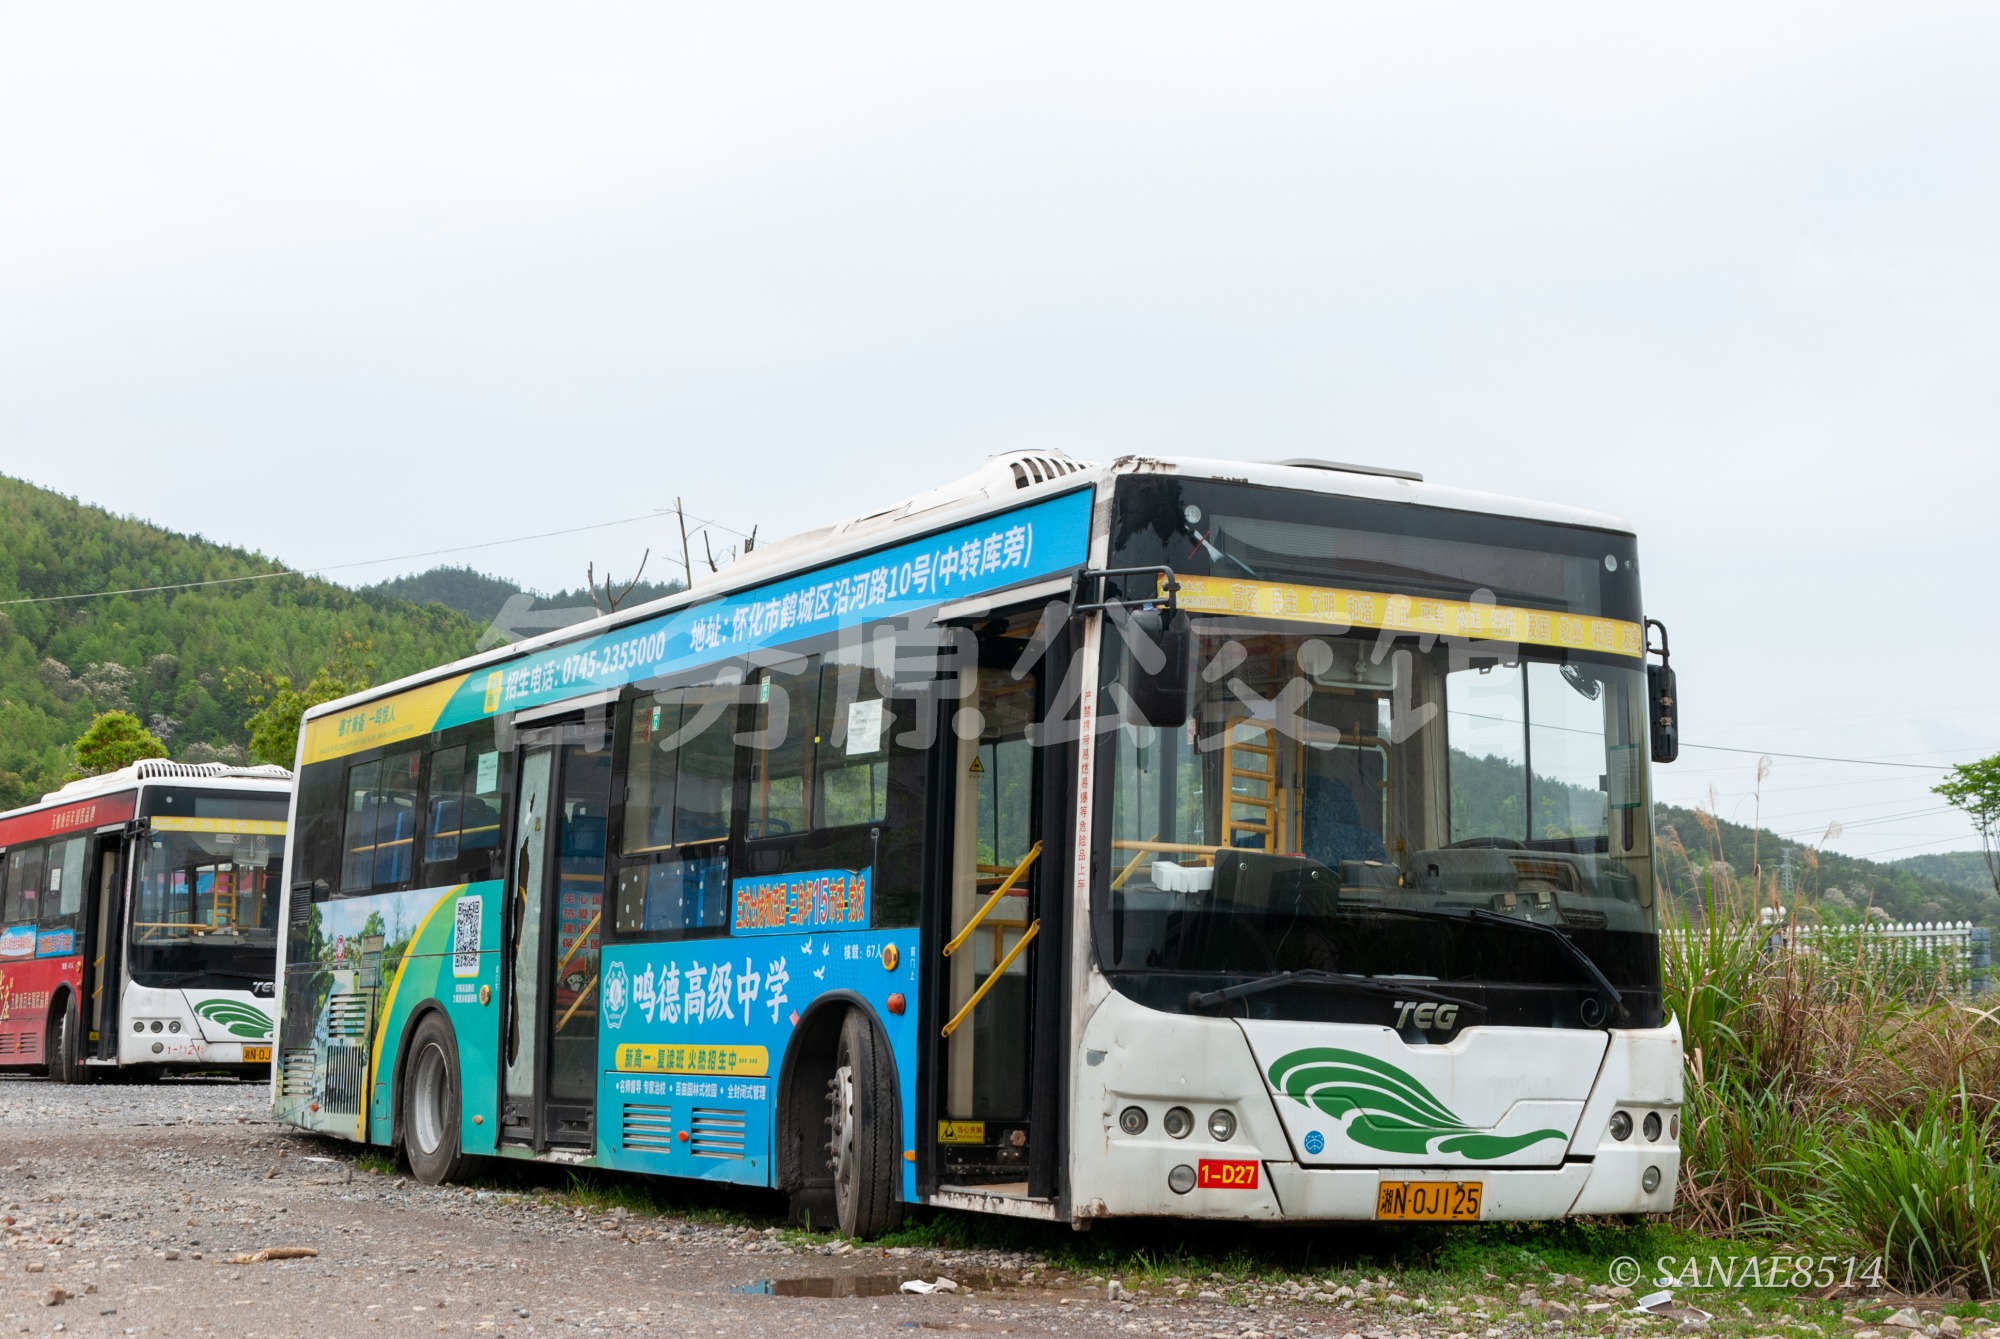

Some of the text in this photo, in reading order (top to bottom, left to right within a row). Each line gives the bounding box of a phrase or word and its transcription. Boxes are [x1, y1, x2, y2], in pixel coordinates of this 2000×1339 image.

[1231, 583, 1259, 613] 富强
[1271, 587, 1298, 616] 民主
[1309, 591, 1336, 619] 文明
[1347, 594, 1373, 623] 和谐
[1385, 598, 1411, 626] 自由
[1421, 602, 1446, 629] 平等
[1456, 606, 1481, 634] 公正
[1492, 609, 1516, 637] 法治
[1527, 613, 1550, 640] 爱国
[1559, 616, 1584, 645] 敬业
[1592, 619, 1614, 649] 诚信
[632, 956, 790, 1027] 鸣德高级中学
[1393, 1001, 1461, 1030] TEG
[727, 1084, 767, 1100] 全封闭式管理
[1200, 1165, 1255, 1187] 1-D27
